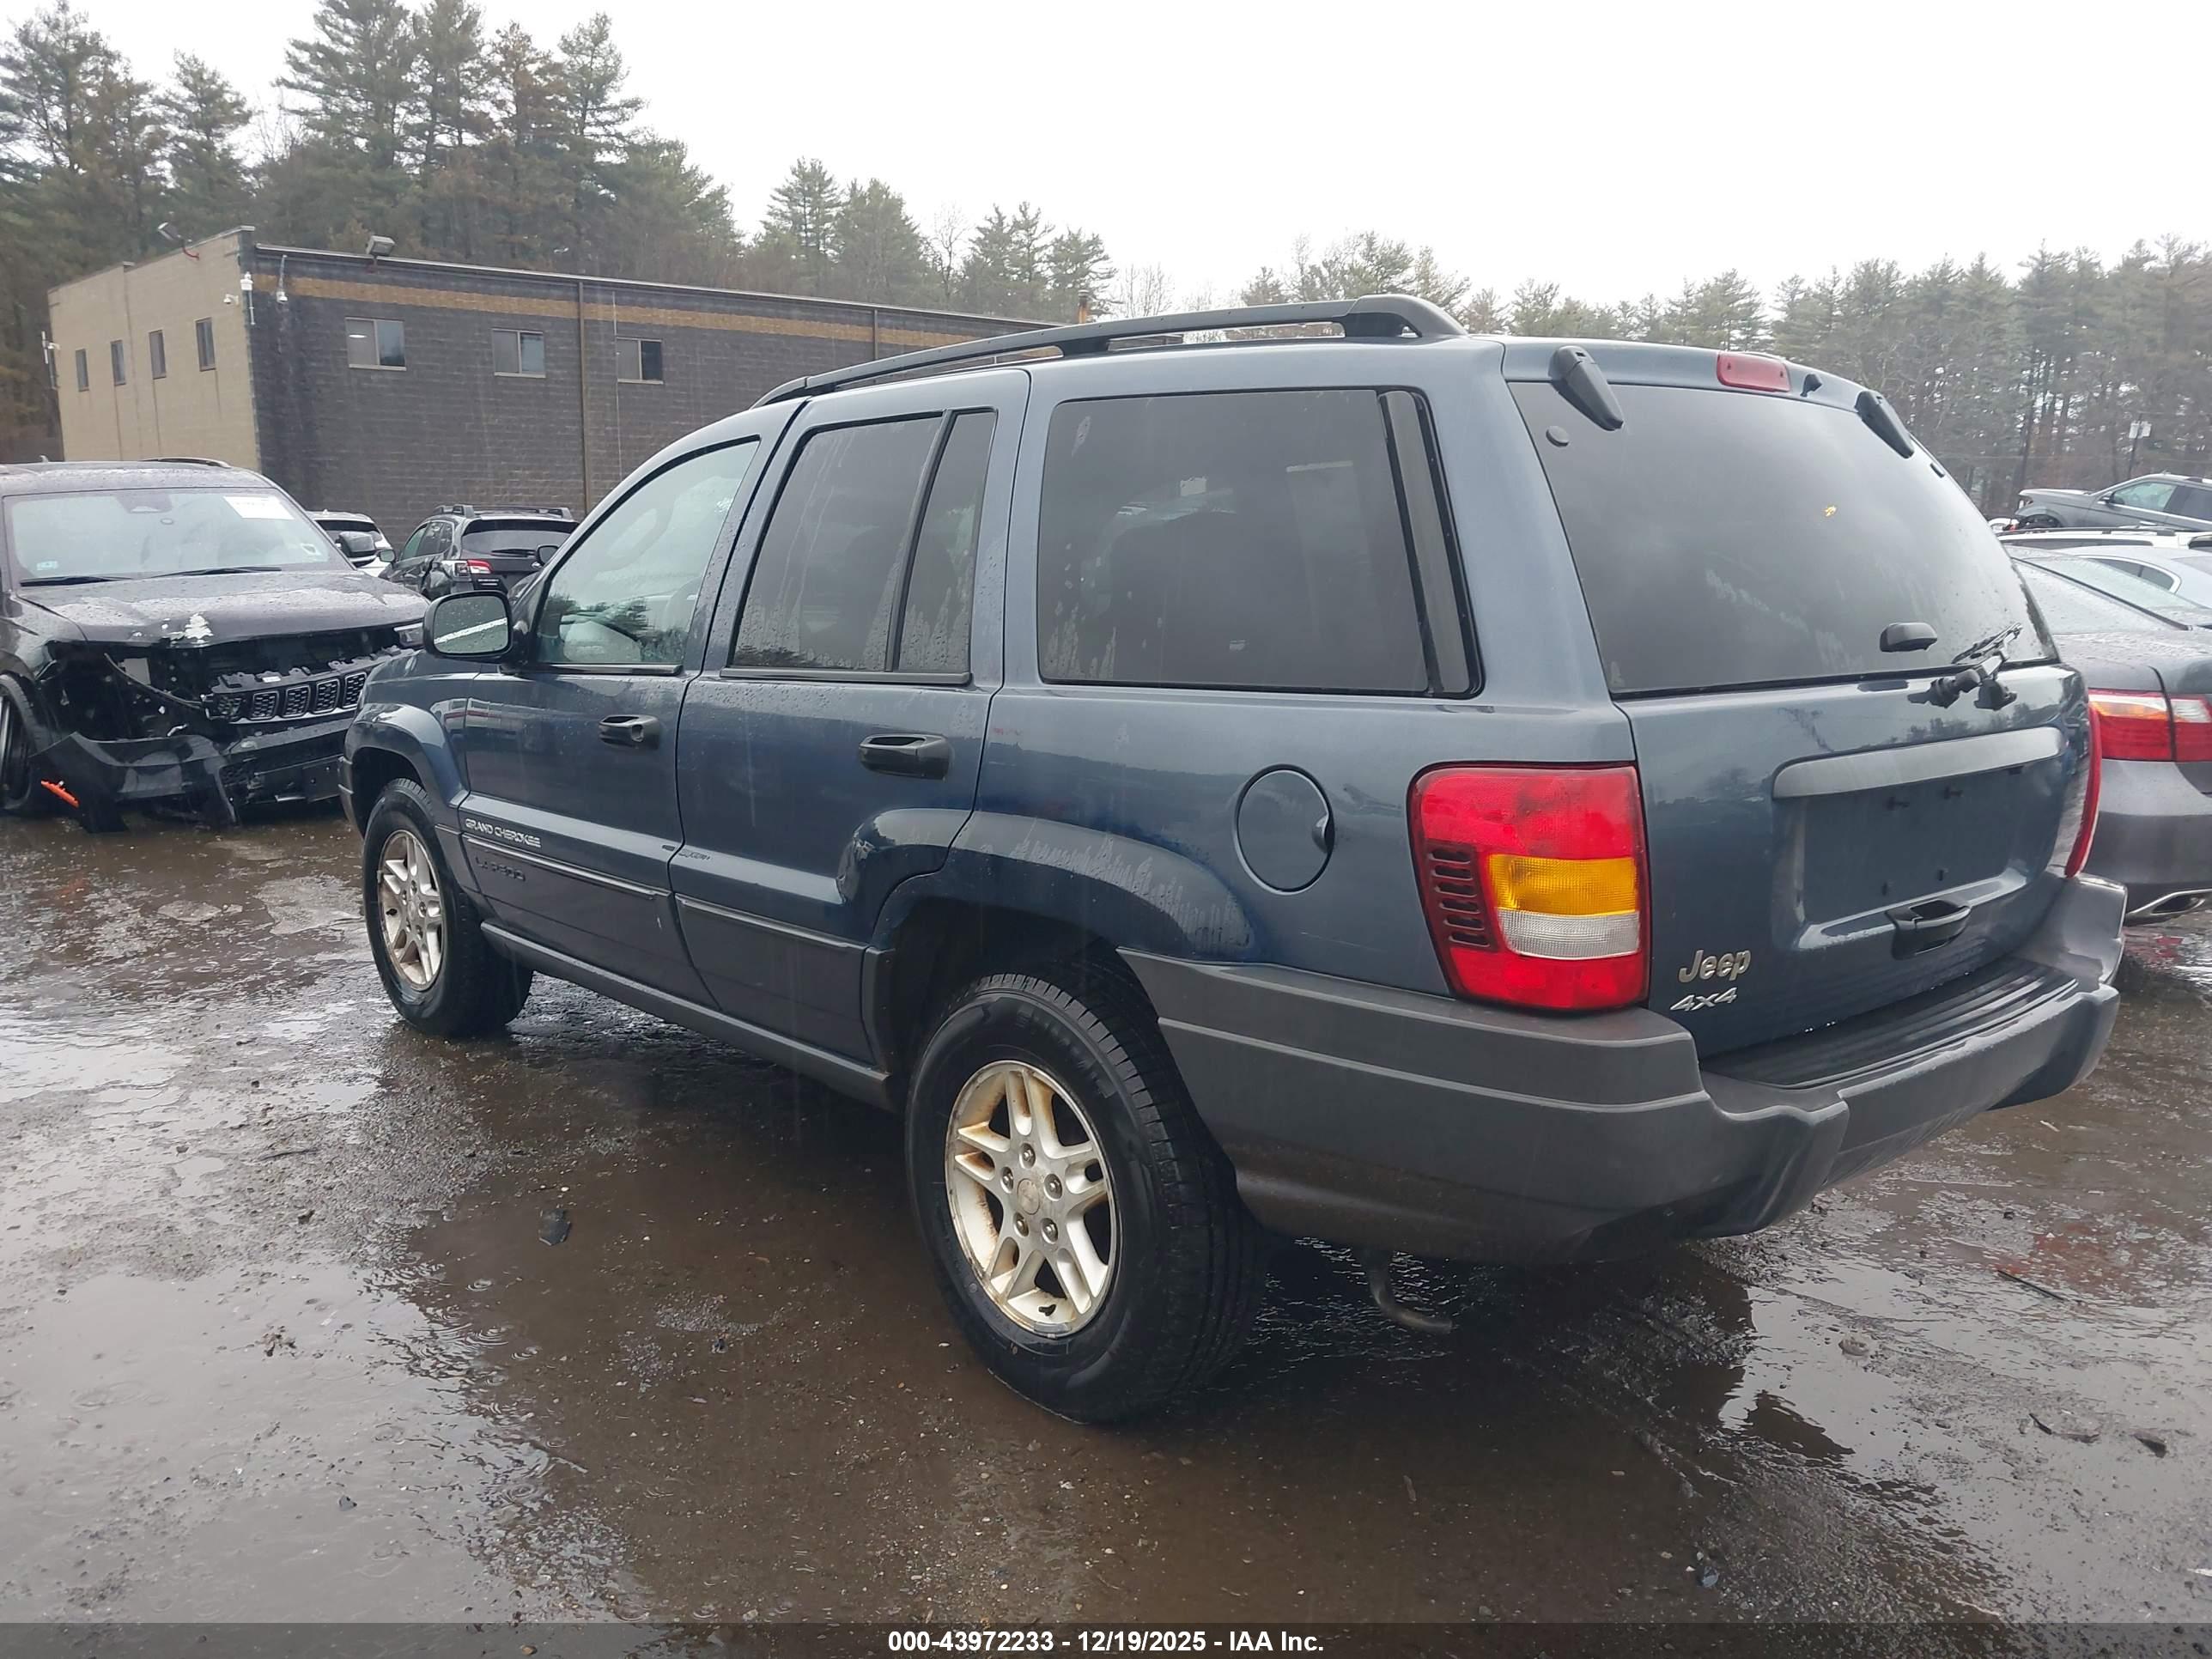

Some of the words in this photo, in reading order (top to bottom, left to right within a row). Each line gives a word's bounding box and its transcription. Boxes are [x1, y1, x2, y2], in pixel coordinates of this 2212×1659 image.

[465, 817, 494, 835] GRAND
[495, 826, 542, 848] CHEROKEE
[1678, 949, 1752, 983] Jeep
